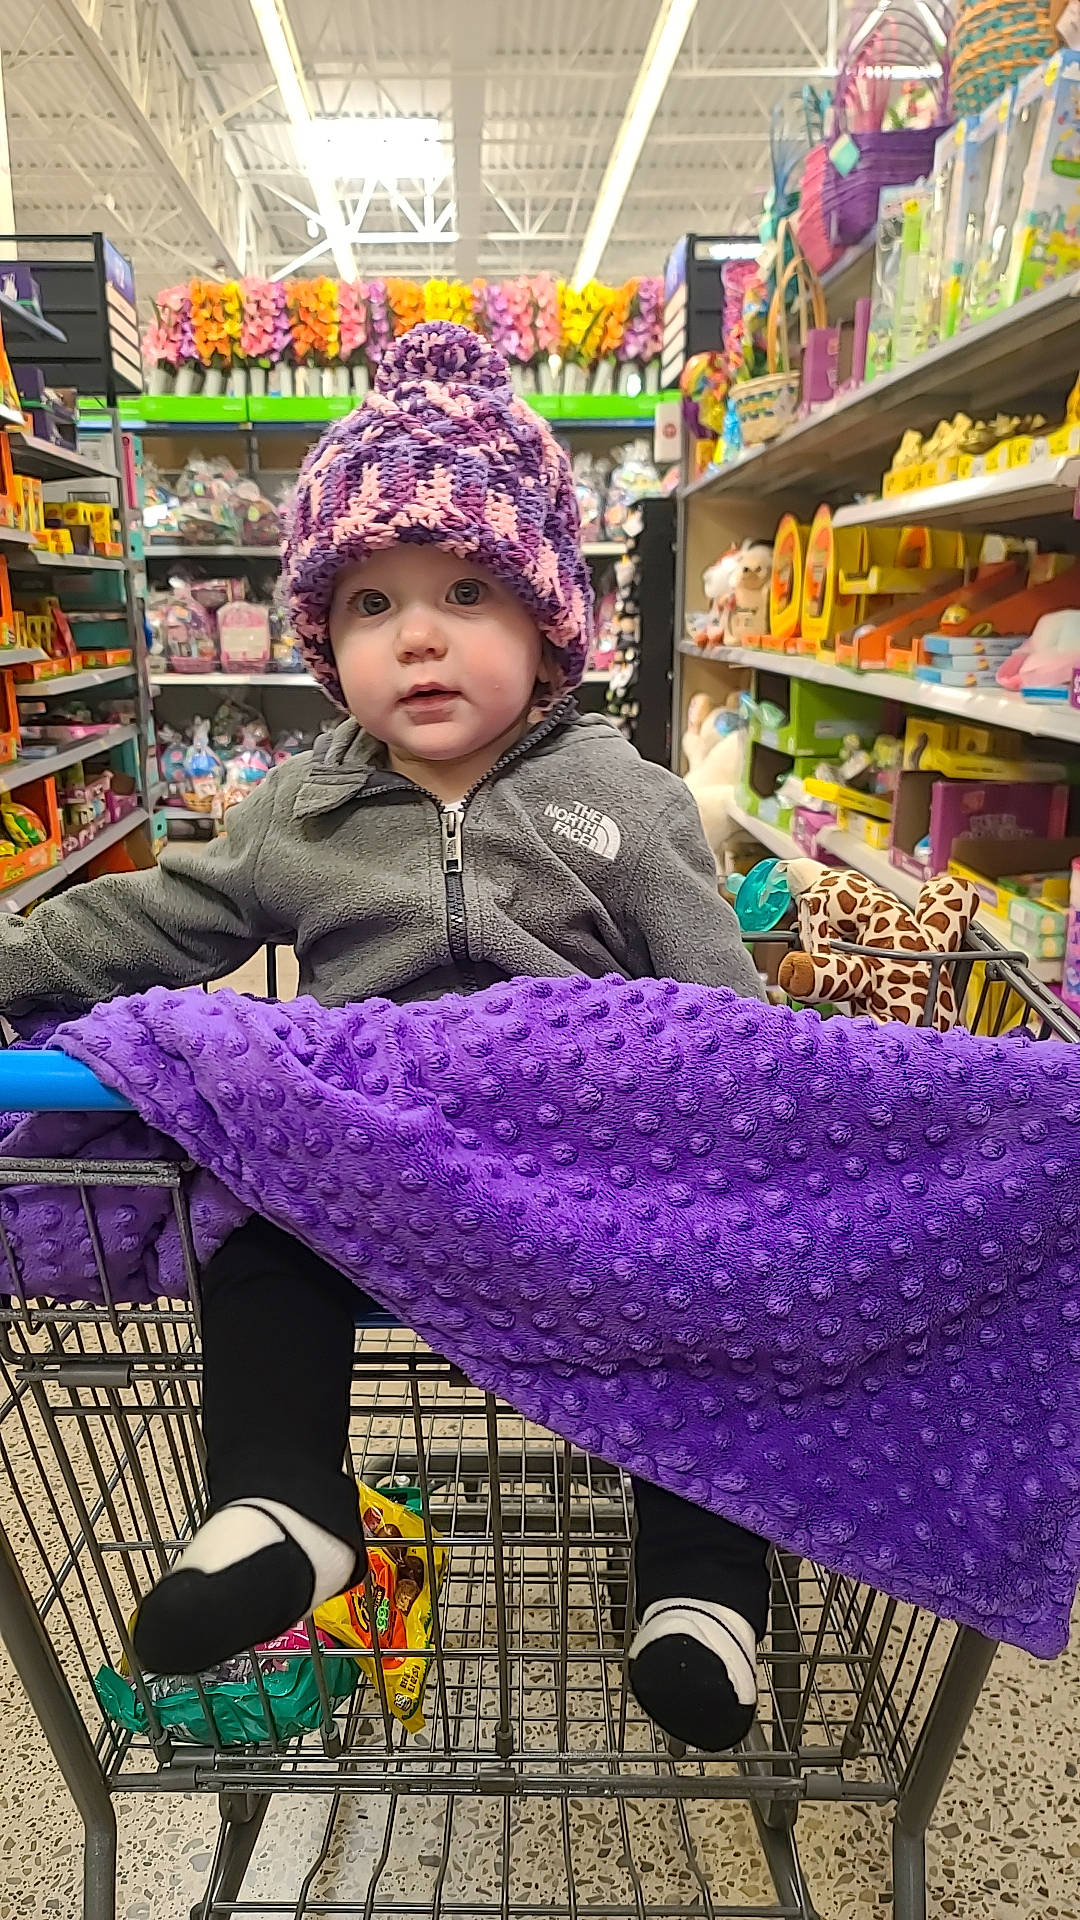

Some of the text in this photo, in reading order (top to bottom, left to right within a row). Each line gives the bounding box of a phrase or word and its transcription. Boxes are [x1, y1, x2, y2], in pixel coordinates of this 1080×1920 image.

[543, 803, 598, 836] NORTH
[572, 800, 603, 823] THE
[551, 820, 593, 846] FACE
